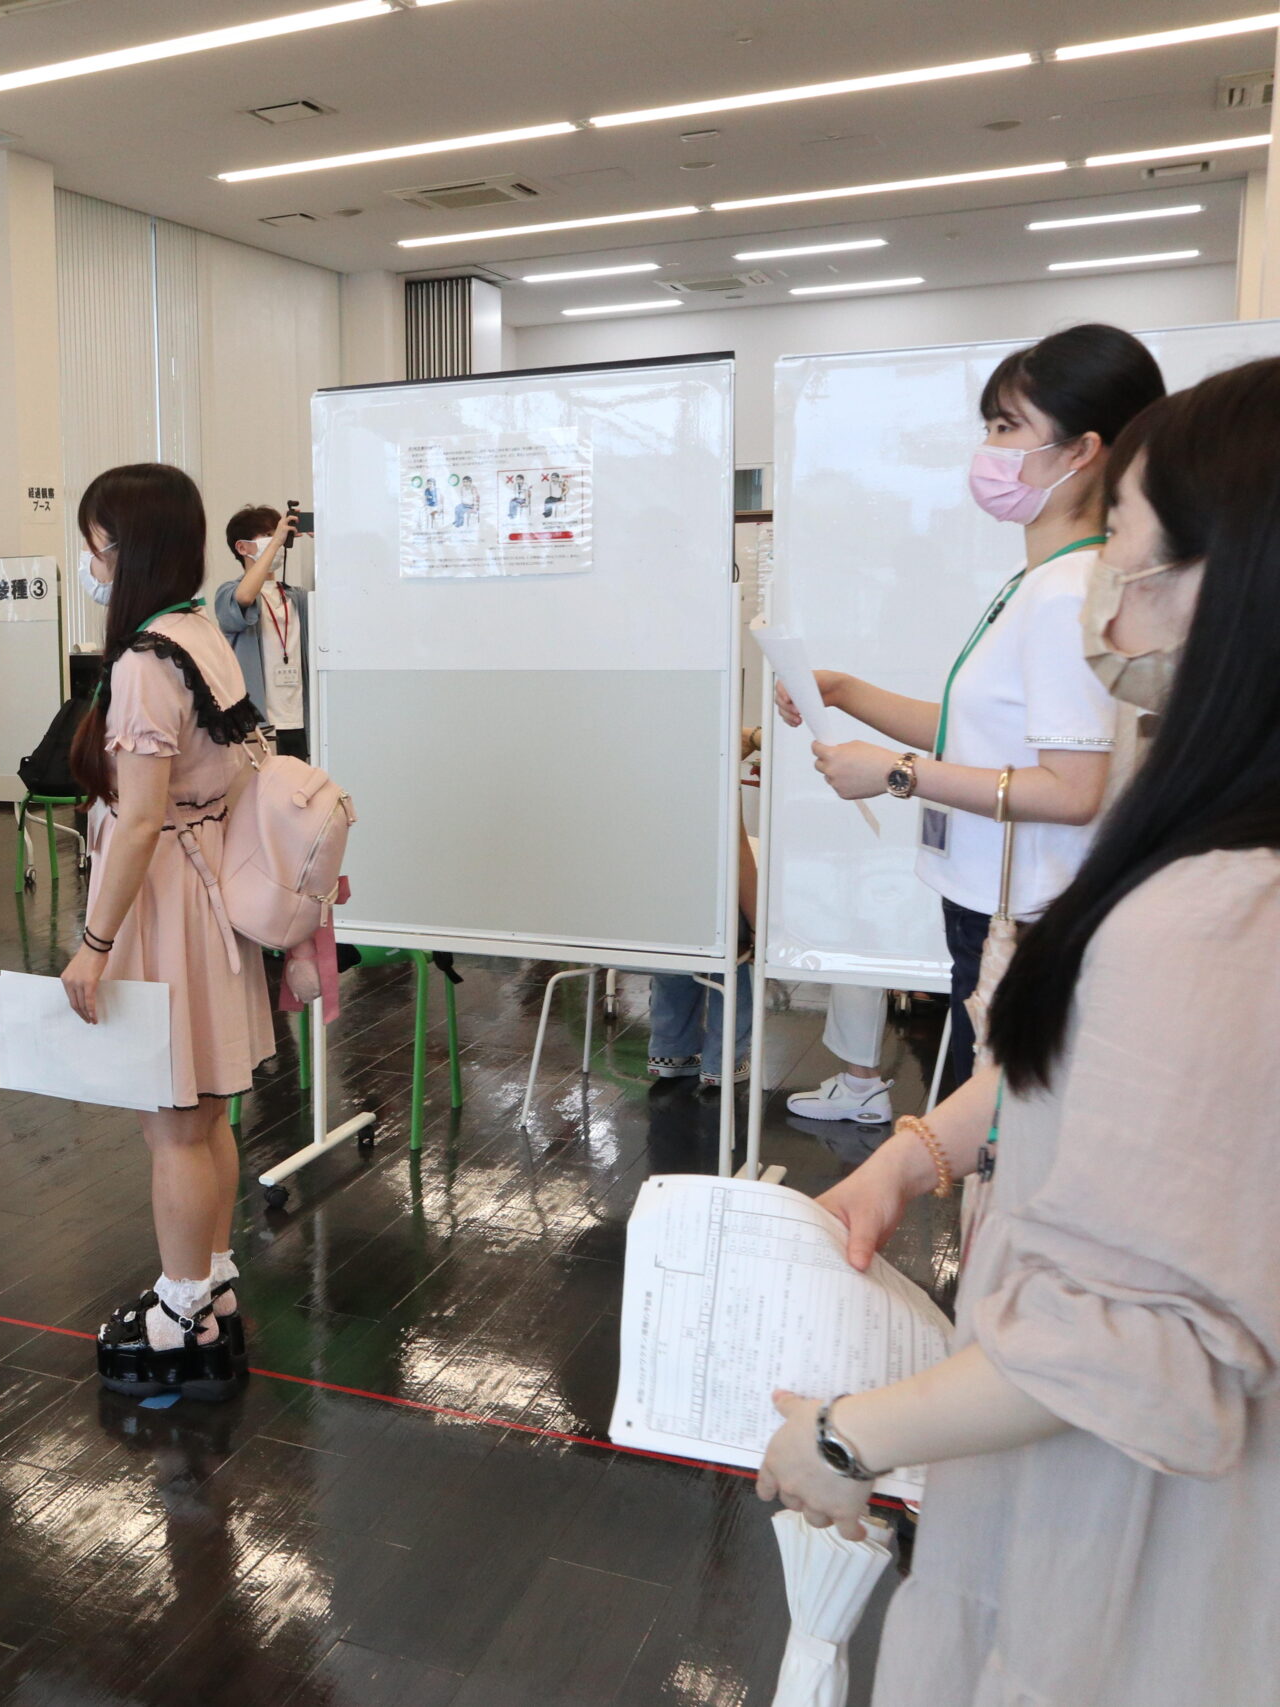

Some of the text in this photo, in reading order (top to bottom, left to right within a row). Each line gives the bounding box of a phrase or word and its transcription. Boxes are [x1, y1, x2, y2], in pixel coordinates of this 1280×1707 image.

[28, 487, 55, 499] 経過観察
[33, 500, 51, 512] ブース
